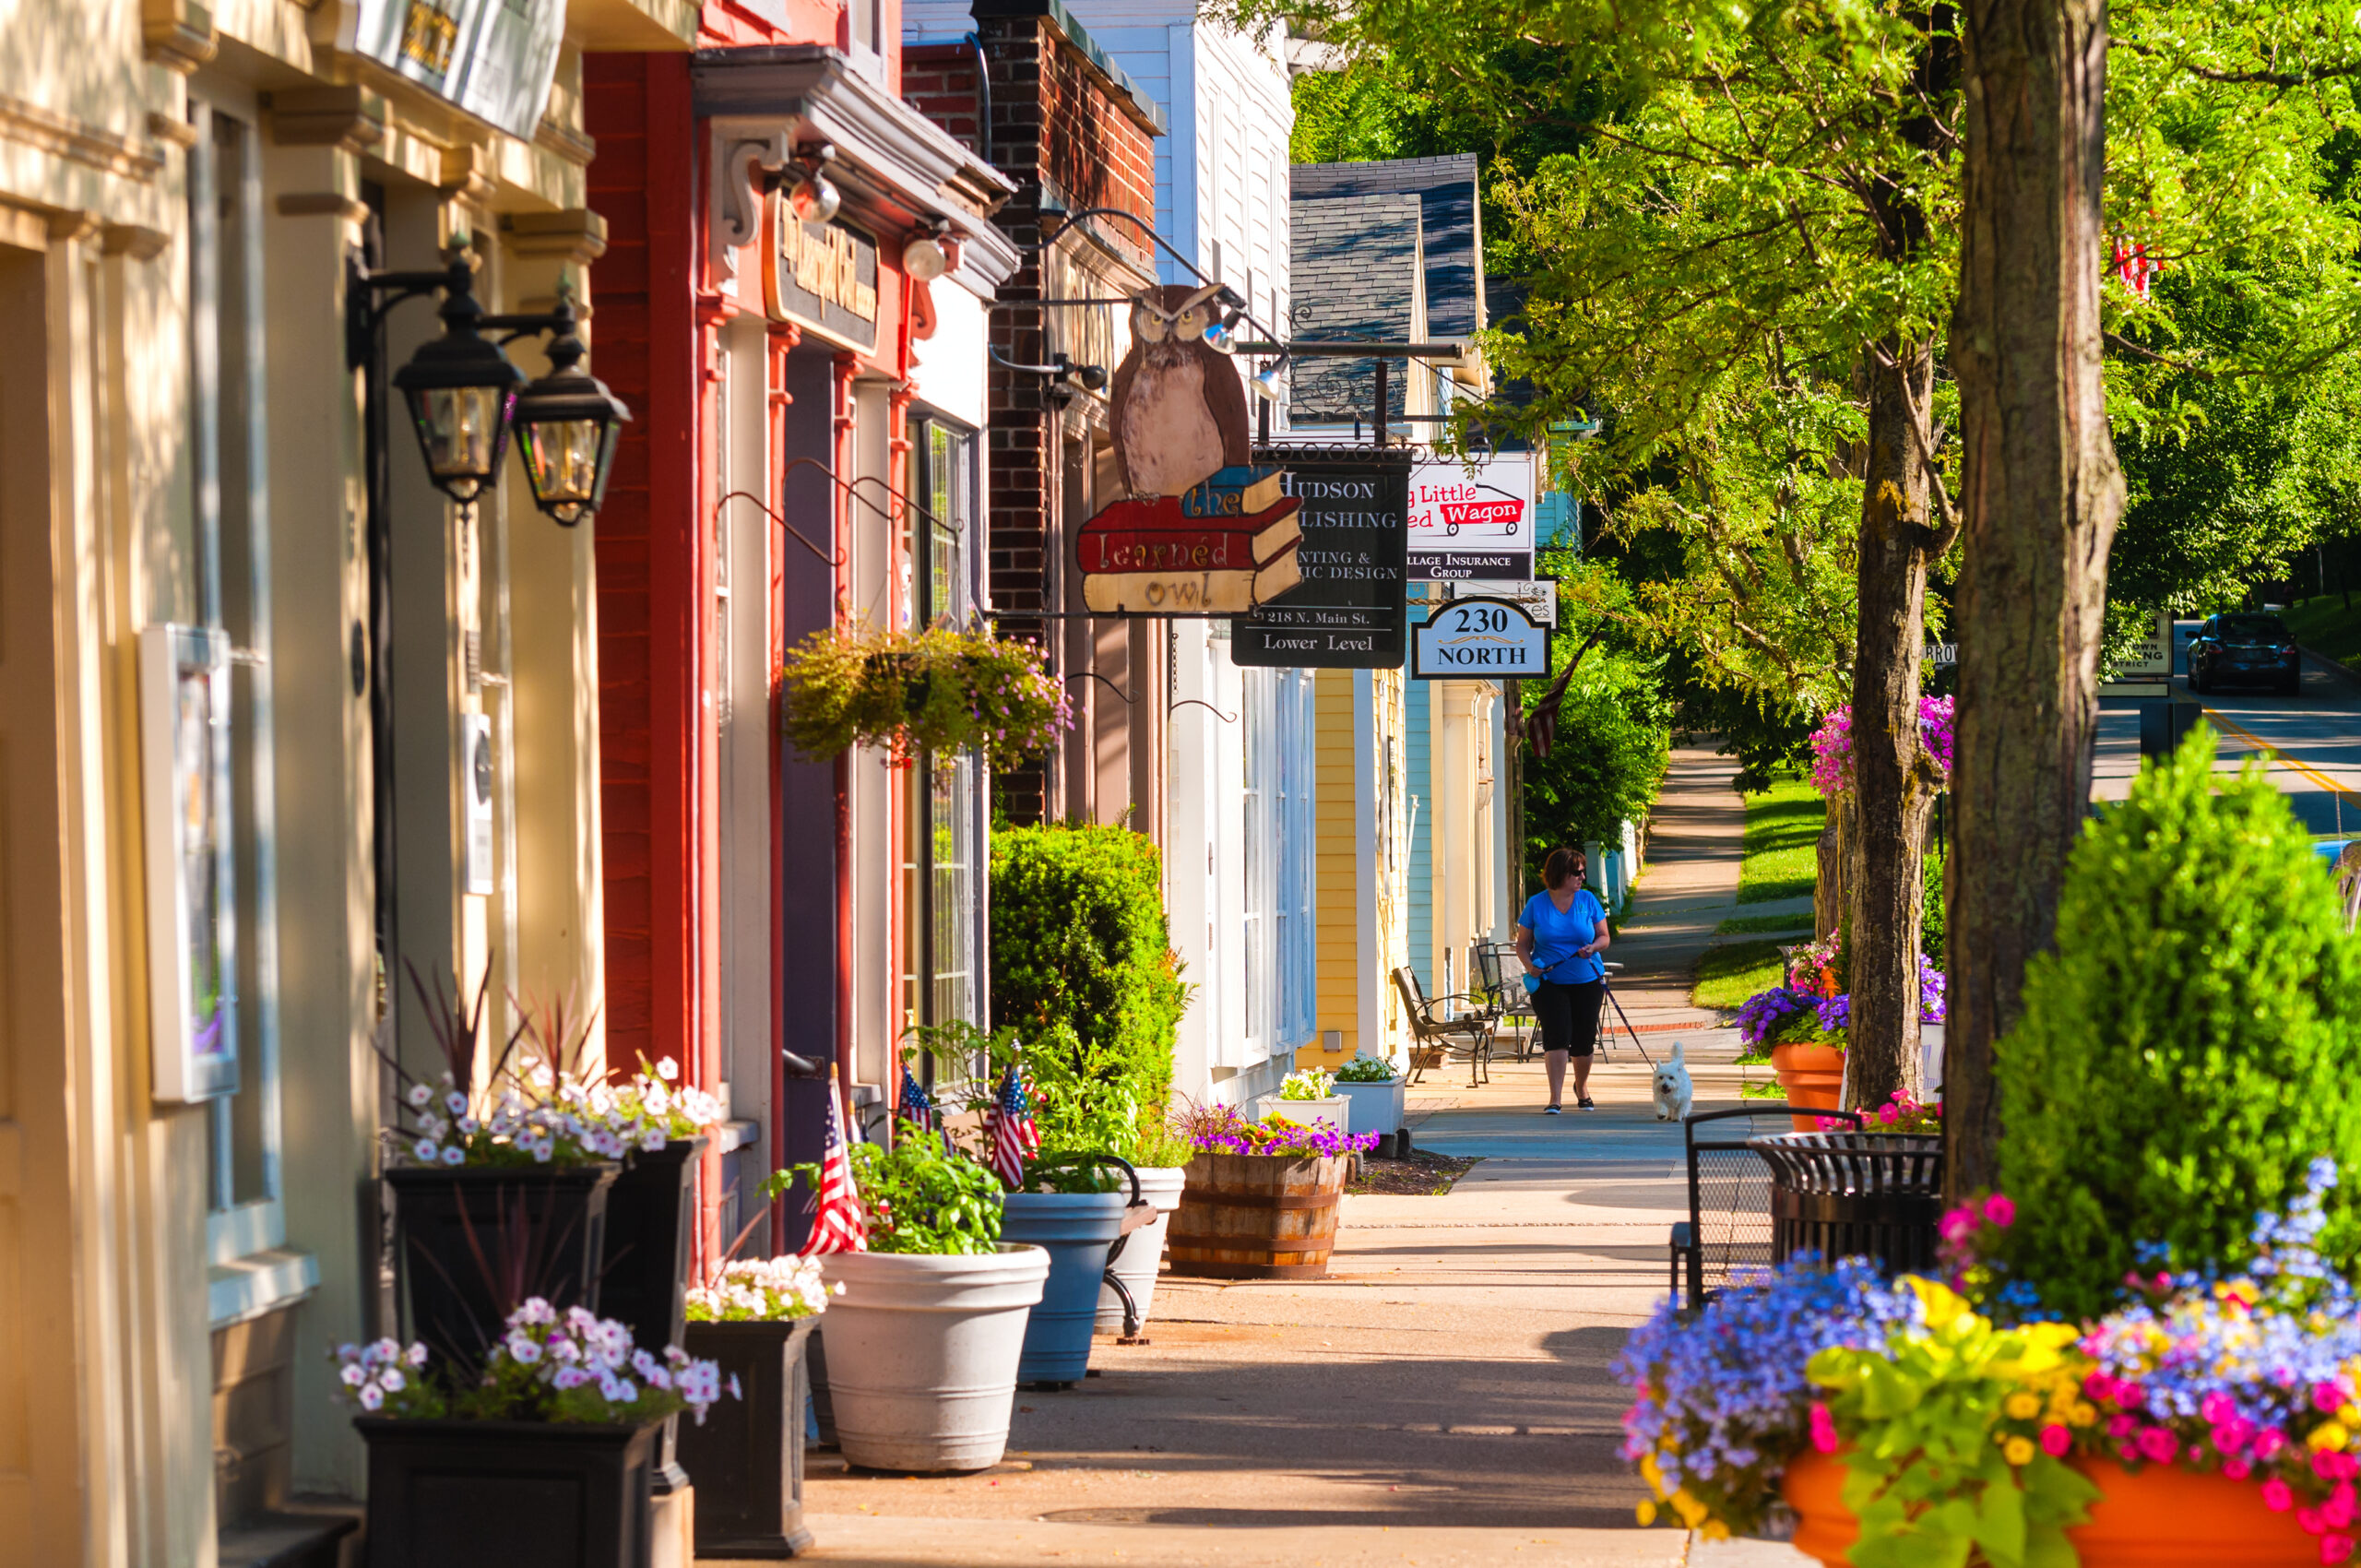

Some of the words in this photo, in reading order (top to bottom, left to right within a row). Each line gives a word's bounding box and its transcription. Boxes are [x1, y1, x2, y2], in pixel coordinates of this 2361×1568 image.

[1190, 480, 1241, 517] the
[1419, 483, 1477, 503] Little
[1300, 511, 1398, 529] LISHING
[1407, 509, 1434, 528] ed
[1447, 505, 1517, 523] Wagon
[1299, 551, 1352, 564] NTING
[1358, 552, 1371, 564] &
[1407, 556, 1442, 565] LLAGE
[1446, 553, 1512, 566] INSURANCE
[1330, 566, 1398, 579] DESIGN
[1430, 565, 1473, 578] GROUP
[1145, 572, 1212, 608] owl
[1267, 612, 1292, 623] 218
[1296, 612, 1311, 624] N.
[1315, 612, 1347, 624] Main
[1352, 613, 1370, 624] St.
[1454, 609, 1508, 633] 230
[1264, 635, 1318, 649] Lower
[1327, 635, 1373, 650] Level
[1437, 647, 1527, 665] NORTH
